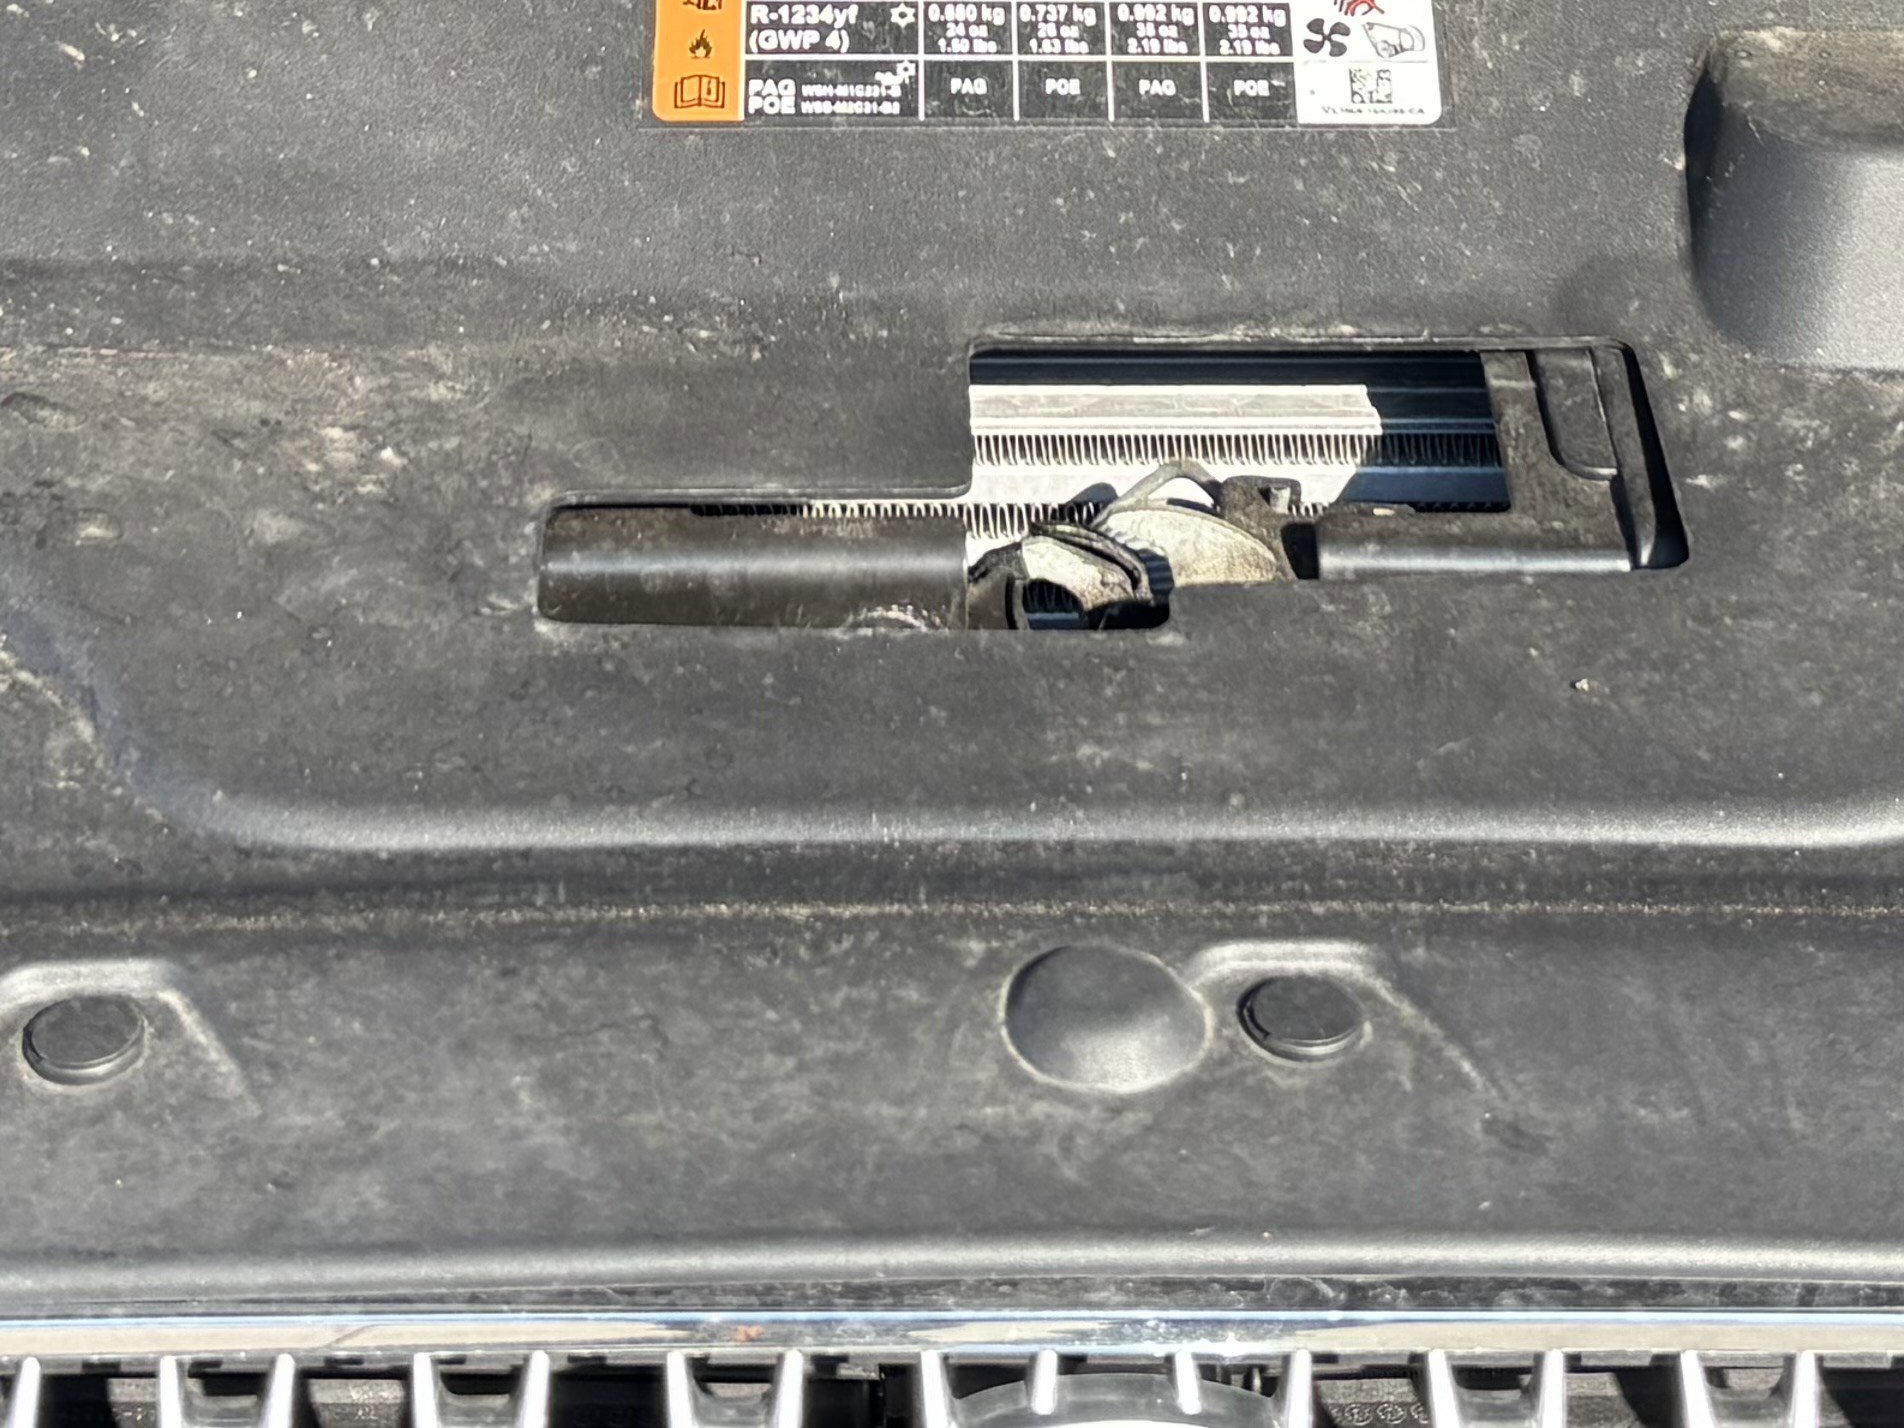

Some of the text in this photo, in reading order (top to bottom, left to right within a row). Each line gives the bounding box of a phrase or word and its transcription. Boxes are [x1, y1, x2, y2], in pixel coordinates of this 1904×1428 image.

[751, 4, 859, 28] R-1234yf
[981, 4, 1006, 26] kg
[1019, 4, 1096, 27] 0.737 kg
[1117, 4, 1195, 26] 0.992 kg
[1209, 5, 1286, 27] 0.992 kg
[946, 22, 988, 37] 24 oz
[1060, 25, 1079, 38] oz
[1158, 25, 1178, 38] oz
[1228, 24, 1270, 39] 35 oz
[749, 29, 850, 53] (GWP 4)
[973, 38, 997, 53] lbs
[1029, 38, 1089, 54] 1.63 lbs
[1127, 38, 1188, 54] 2.19 lbs
[1219, 39, 1280, 55] 2.19 lbs
[748, 79, 795, 96] PAG
[950, 78, 988, 94] PAG
[1045, 78, 1081, 95] POE
[1138, 79, 1177, 95] PAG
[1233, 79, 1270, 96] POE
[748, 96, 795, 114] POE
